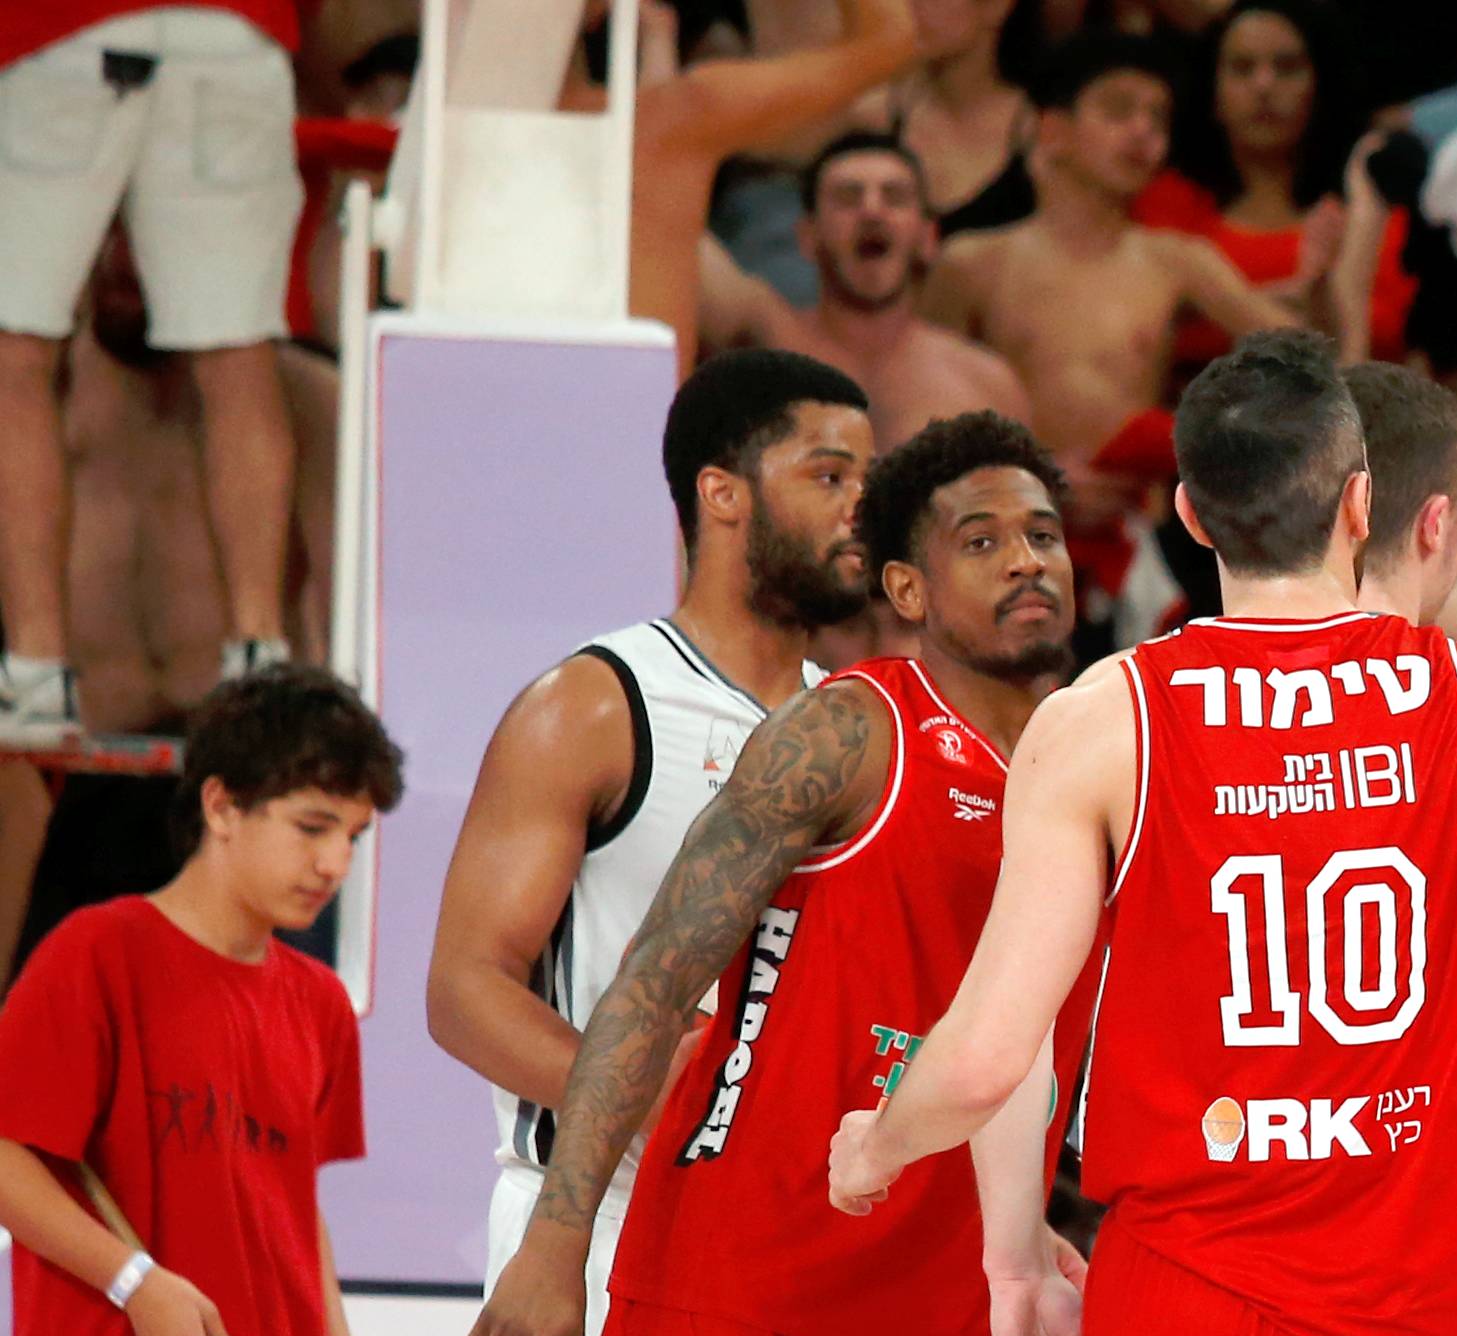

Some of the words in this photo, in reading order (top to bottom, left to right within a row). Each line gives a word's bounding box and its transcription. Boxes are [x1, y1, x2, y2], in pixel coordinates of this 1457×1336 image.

[1168, 654, 1432, 729] טימור
[1283, 751, 1333, 783] בית
[1339, 743, 1416, 810] IBI
[948, 787, 996, 811] Reebok
[1213, 783, 1335, 819] השקעות
[1210, 846, 1427, 1046] 10
[684, 907, 800, 1162] HAPOEL
[870, 1024, 926, 1062] יד
[1376, 1085, 1432, 1117] רענן
[1247, 1094, 1376, 1162] RK
[1384, 1120, 1424, 1154] כץ
